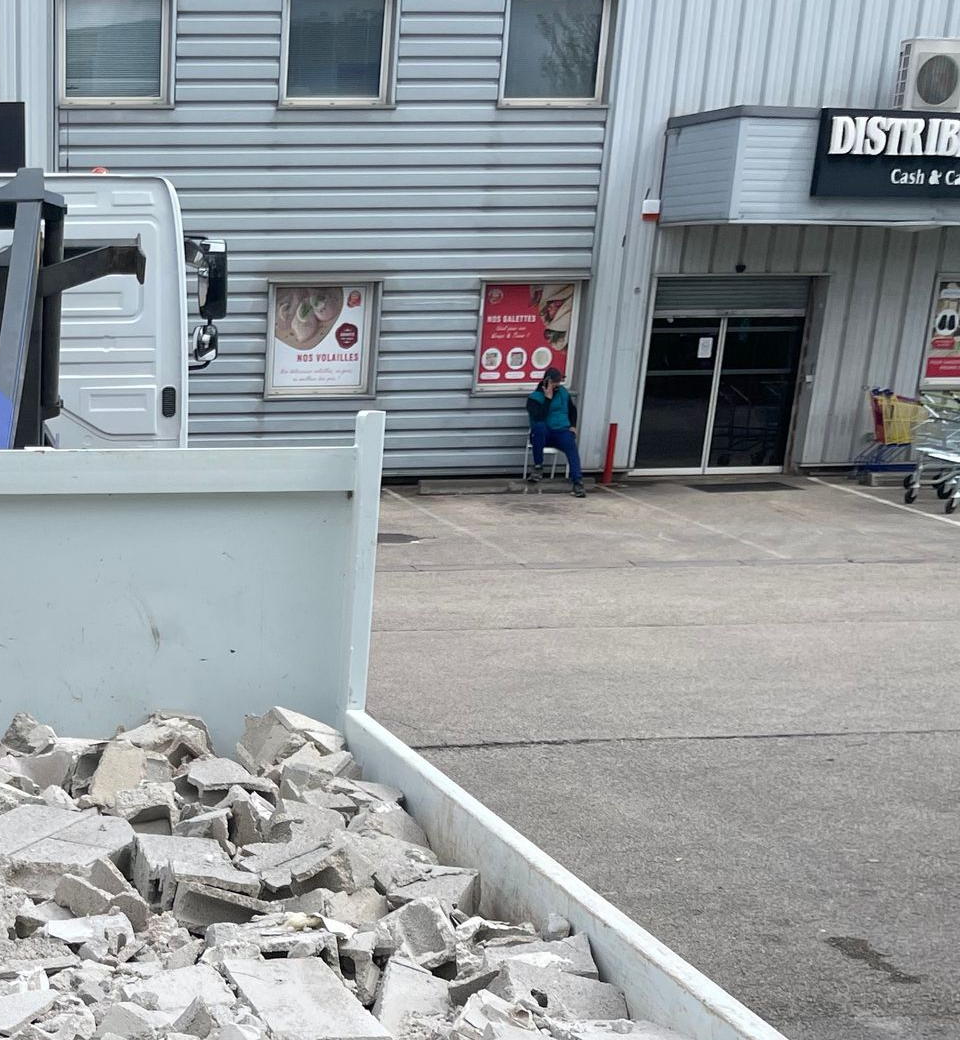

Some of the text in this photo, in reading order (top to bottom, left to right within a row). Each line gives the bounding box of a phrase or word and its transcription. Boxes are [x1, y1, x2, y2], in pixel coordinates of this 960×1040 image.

[827, 115, 960, 157] DISTRIB
[890, 168, 926, 185] Cash
[928, 169, 943, 185] &
[296, 352, 359, 362] NOS VOLAILLES
